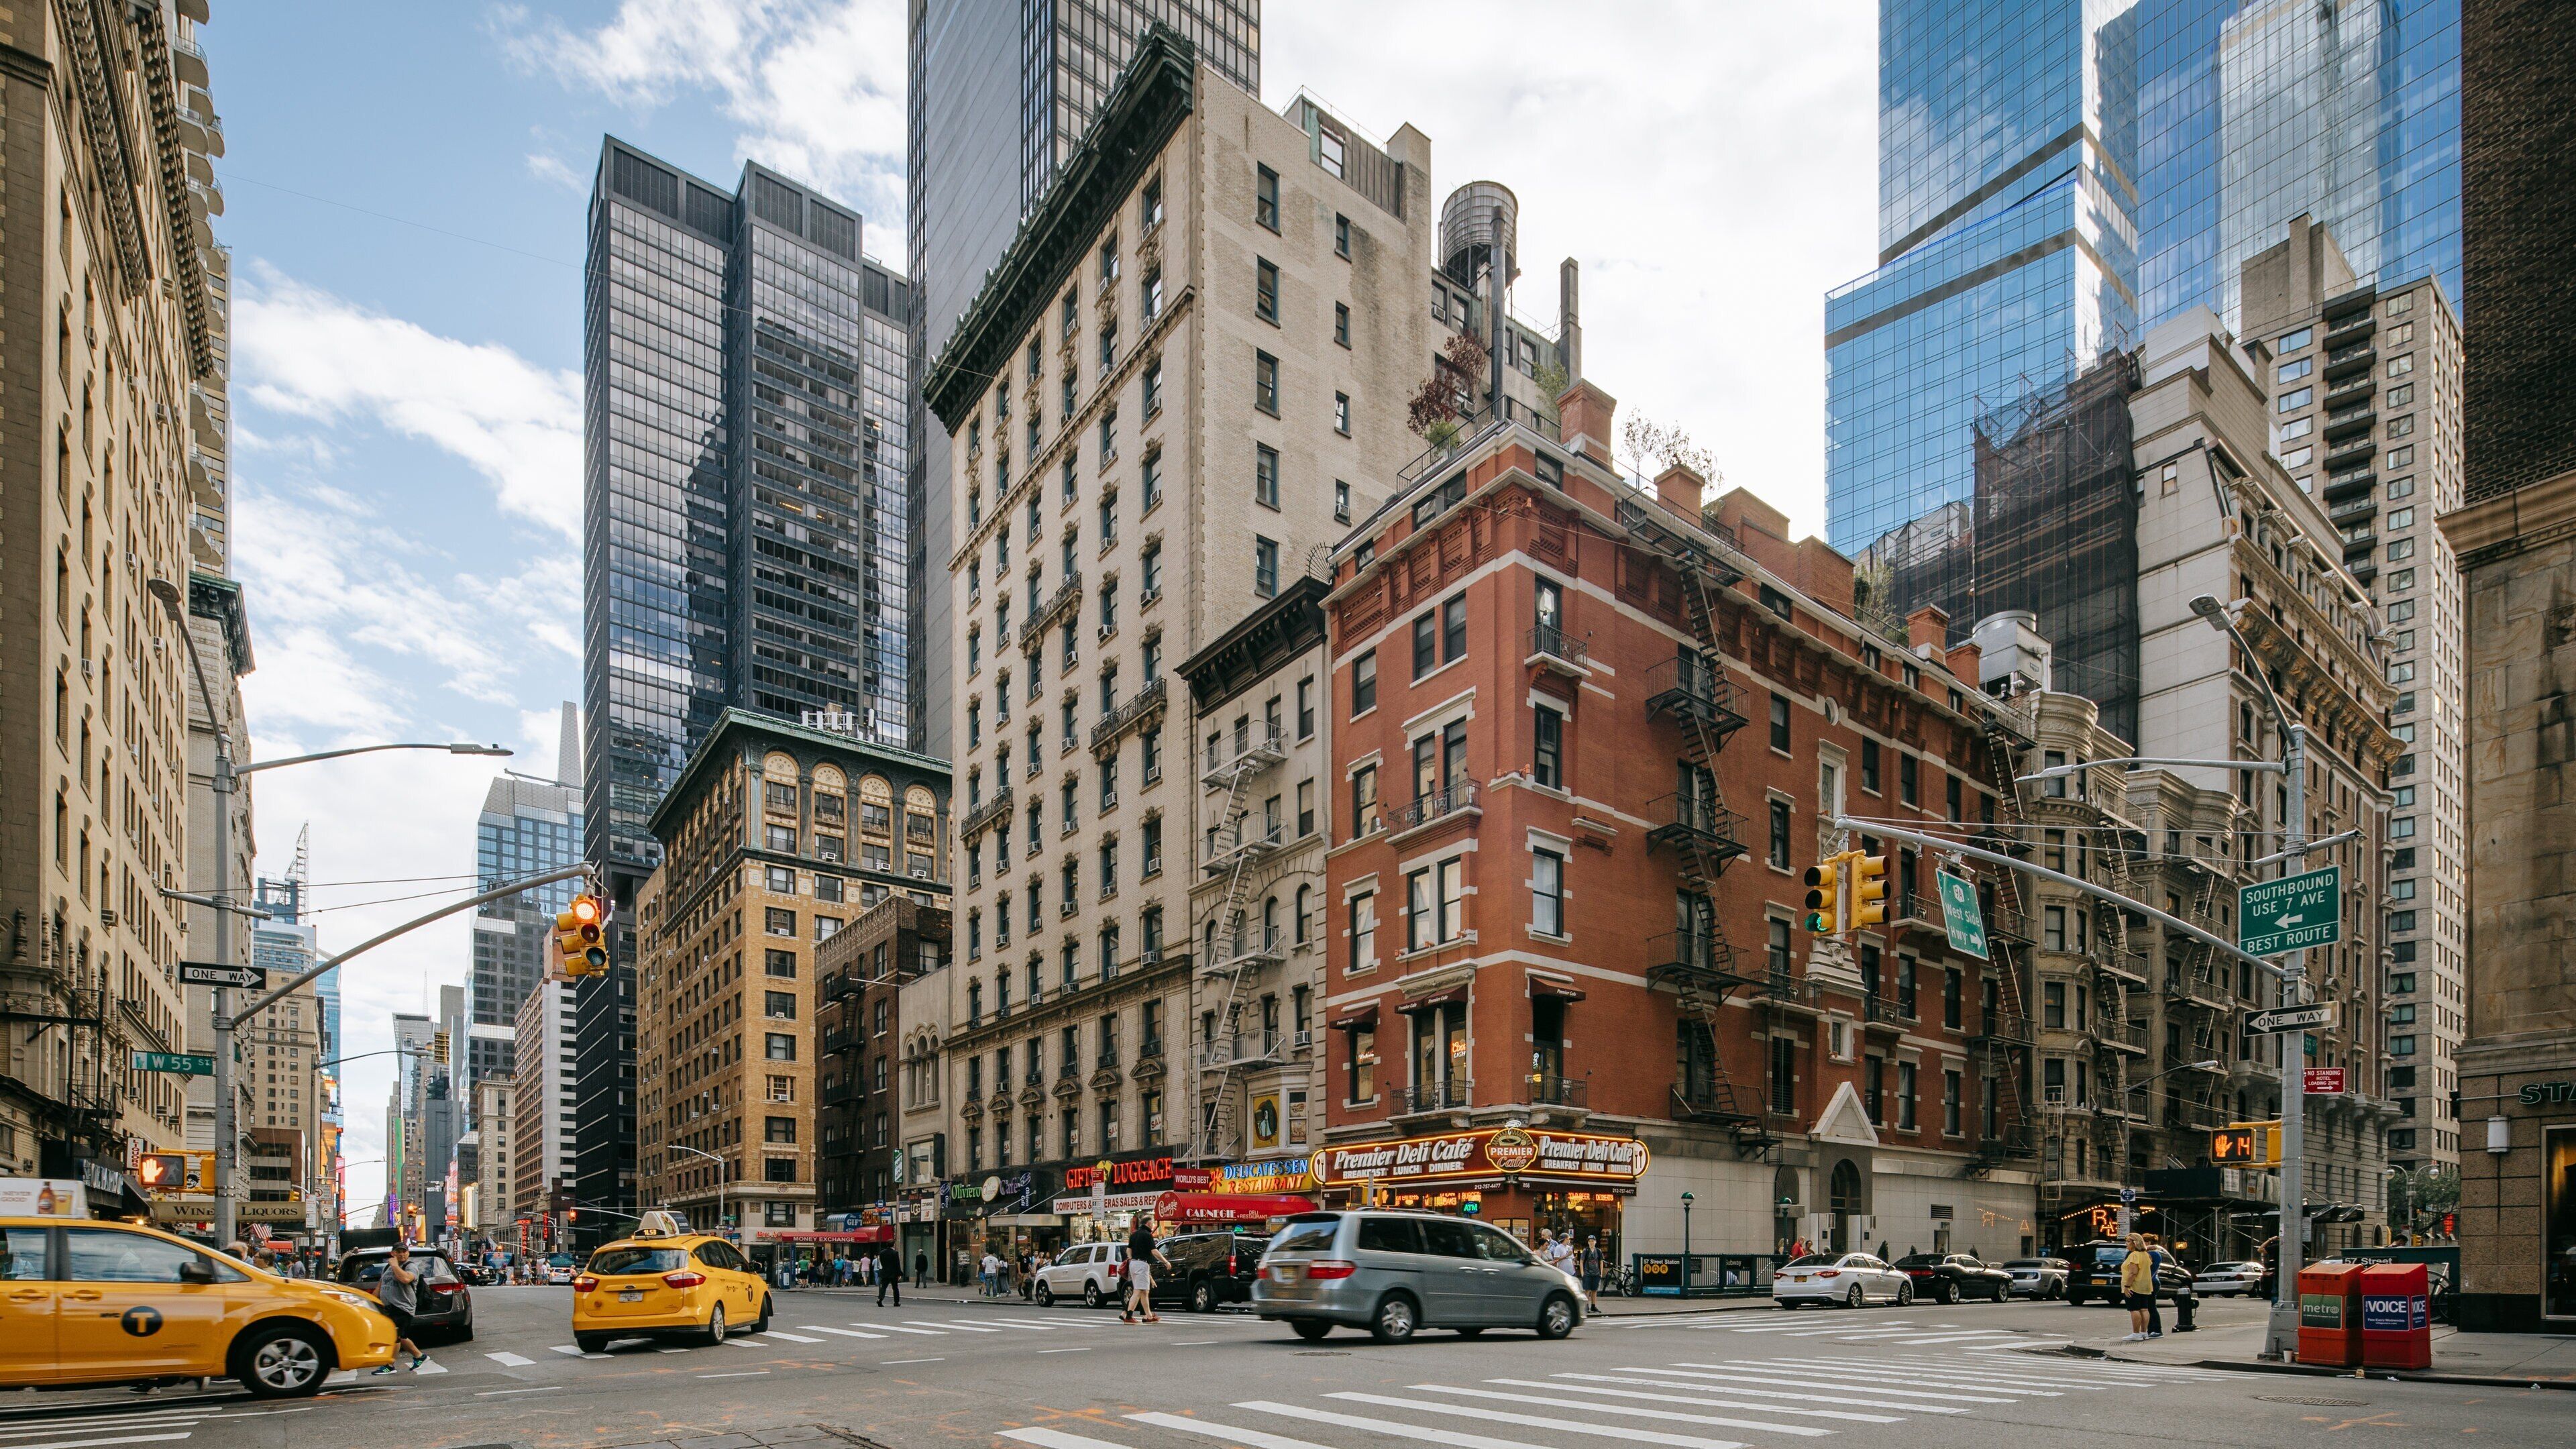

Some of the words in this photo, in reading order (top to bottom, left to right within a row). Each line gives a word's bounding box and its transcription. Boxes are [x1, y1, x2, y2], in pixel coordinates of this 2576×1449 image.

[1955, 888, 1963, 900] 9A
[2246, 874, 2334, 904] SOUTHBOUND
[2253, 901, 2278, 916] USE
[2285, 898, 2293, 910] 7
[2300, 890, 2325, 907] AVE
[1945, 903, 1964, 920] West
[1965, 910, 1980, 926] Side
[1950, 926, 1967, 945] Hwy
[2247, 936, 2279, 953] BEST
[2286, 926, 2330, 945] ROUTE
[192, 969, 217, 979] ONE
[229, 972, 254, 982] WAY
[2258, 1015, 2284, 1027] ONE
[2296, 1010, 2324, 1023] WAY
[2305, 1038, 2312, 1052] 55
[152, 1055, 165, 1069] W
[171, 1057, 192, 1071] 55
[2519, 1081, 2576, 1104] ST
[131, 1139, 140, 1167] LIQUORS
[1334, 1146, 1397, 1170] Premier
[1397, 1141, 1433, 1165] Deli
[1432, 1137, 1477, 1161] Café
[1490, 1147, 1533, 1156] PREMIER
[1539, 1135, 1586, 1159] Premier
[1585, 1139, 1609, 1161] Deli
[1609, 1142, 1634, 1163] Café
[2237, 1136, 2250, 1156] 14
[1224, 1159, 1308, 1179] DELICATESSEN
[1393, 1165, 1422, 1175] LUNCH
[1429, 1162, 1464, 1173] DINNER
[1497, 1155, 1527, 1168] Café
[1541, 1159, 1580, 1171] BREAKFAST
[1582, 1162, 1605, 1172] LUNCH
[1607, 1164, 1631, 1173] DINNER
[1114, 1157, 1173, 1184] LUGGAGE
[1175, 1175, 1197, 1184] WORLD'S
[1197, 1175, 1210, 1184] BEST
[1229, 1175, 1305, 1194] RESTAURANT
[173, 1205, 215, 1216] WINE
[241, 1206, 298, 1216] LIQUORS
[910, 1203, 921, 1216] UGG
[1056, 1199, 1087, 1210] COMPUTERS
[1087, 1199, 1092, 1209] &
[1104, 1197, 1119, 1208] ERAS
[1120, 1196, 1138, 1208] SALES
[1138, 1195, 1143, 1206] &
[1158, 1199, 1178, 1218] Carnegie
[1464, 1203, 1478, 1212] ATM
[1186, 1208, 1236, 1218] CARNEGIE
[2368, 1300, 2407, 1313] VOICE
